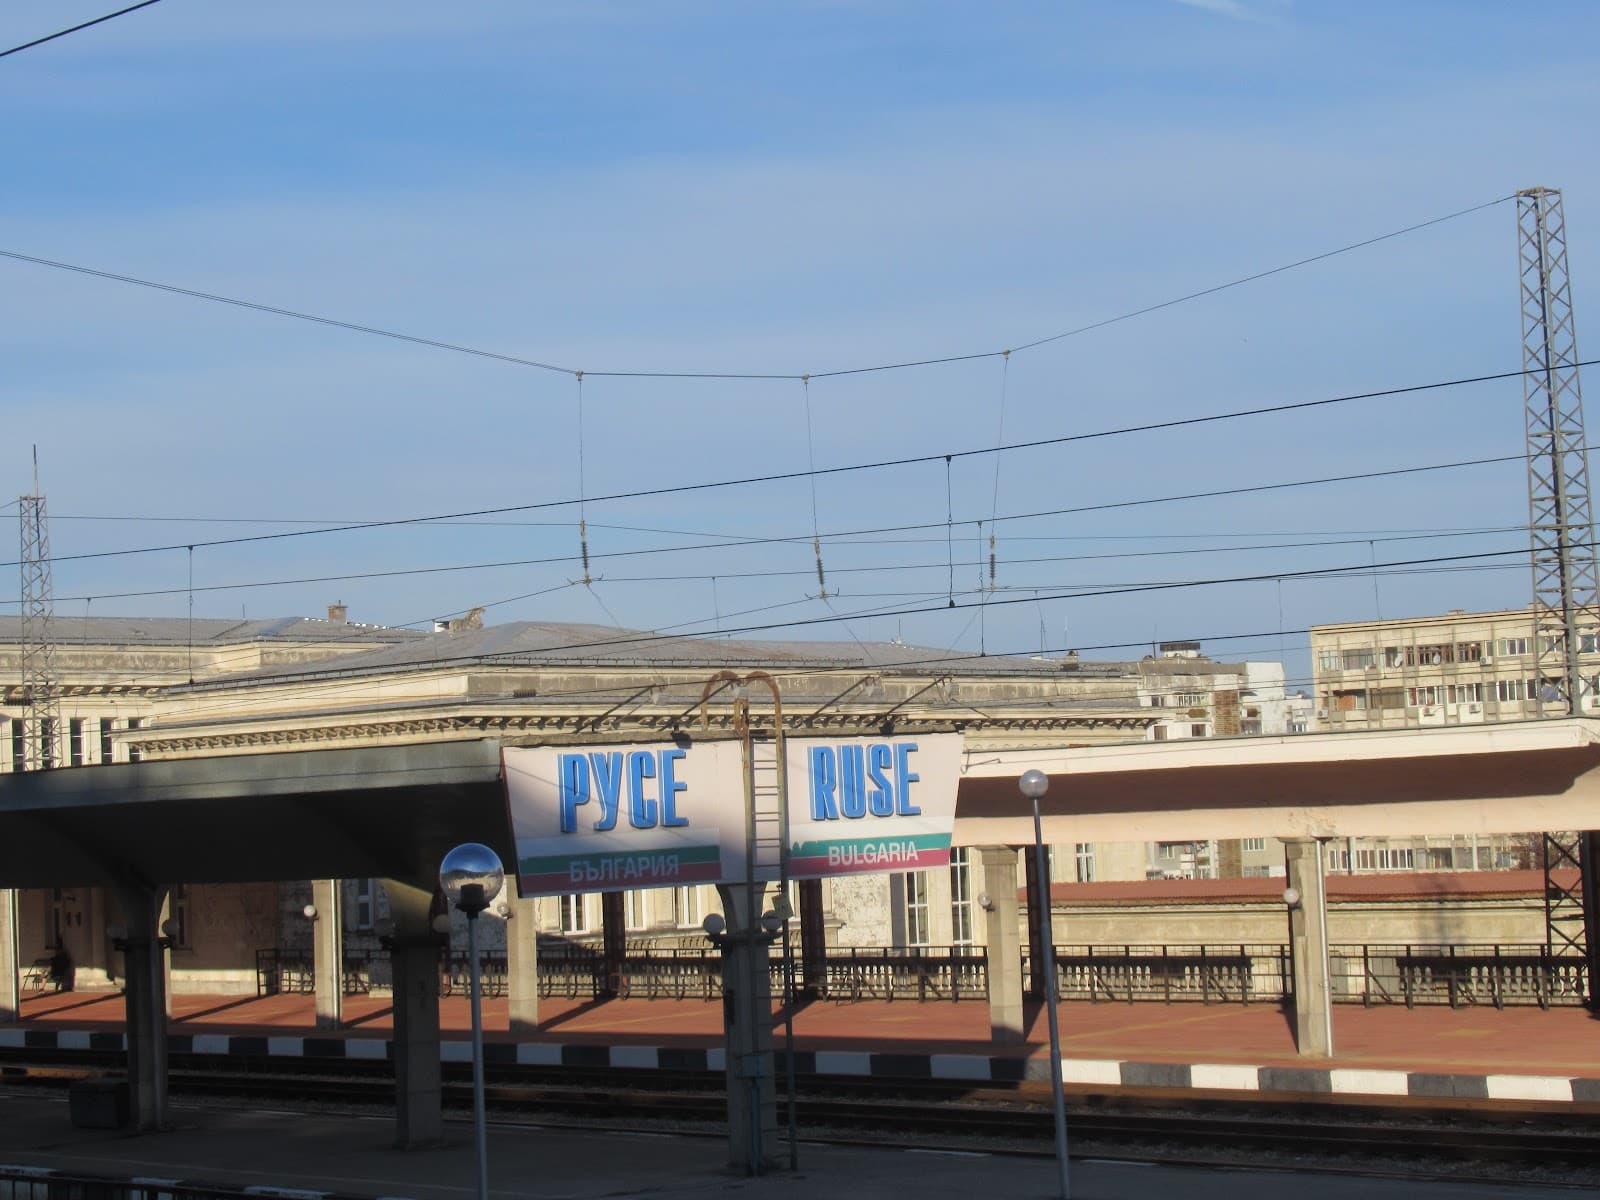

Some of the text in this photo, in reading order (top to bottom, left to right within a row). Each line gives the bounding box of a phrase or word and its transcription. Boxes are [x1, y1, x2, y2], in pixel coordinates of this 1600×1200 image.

[558, 749, 689, 833] РУСЕ
[808, 743, 922, 821] RUSE
[570, 854, 680, 882] БЪЛГАРИЯ
[829, 841, 919, 866] BULGARIA
